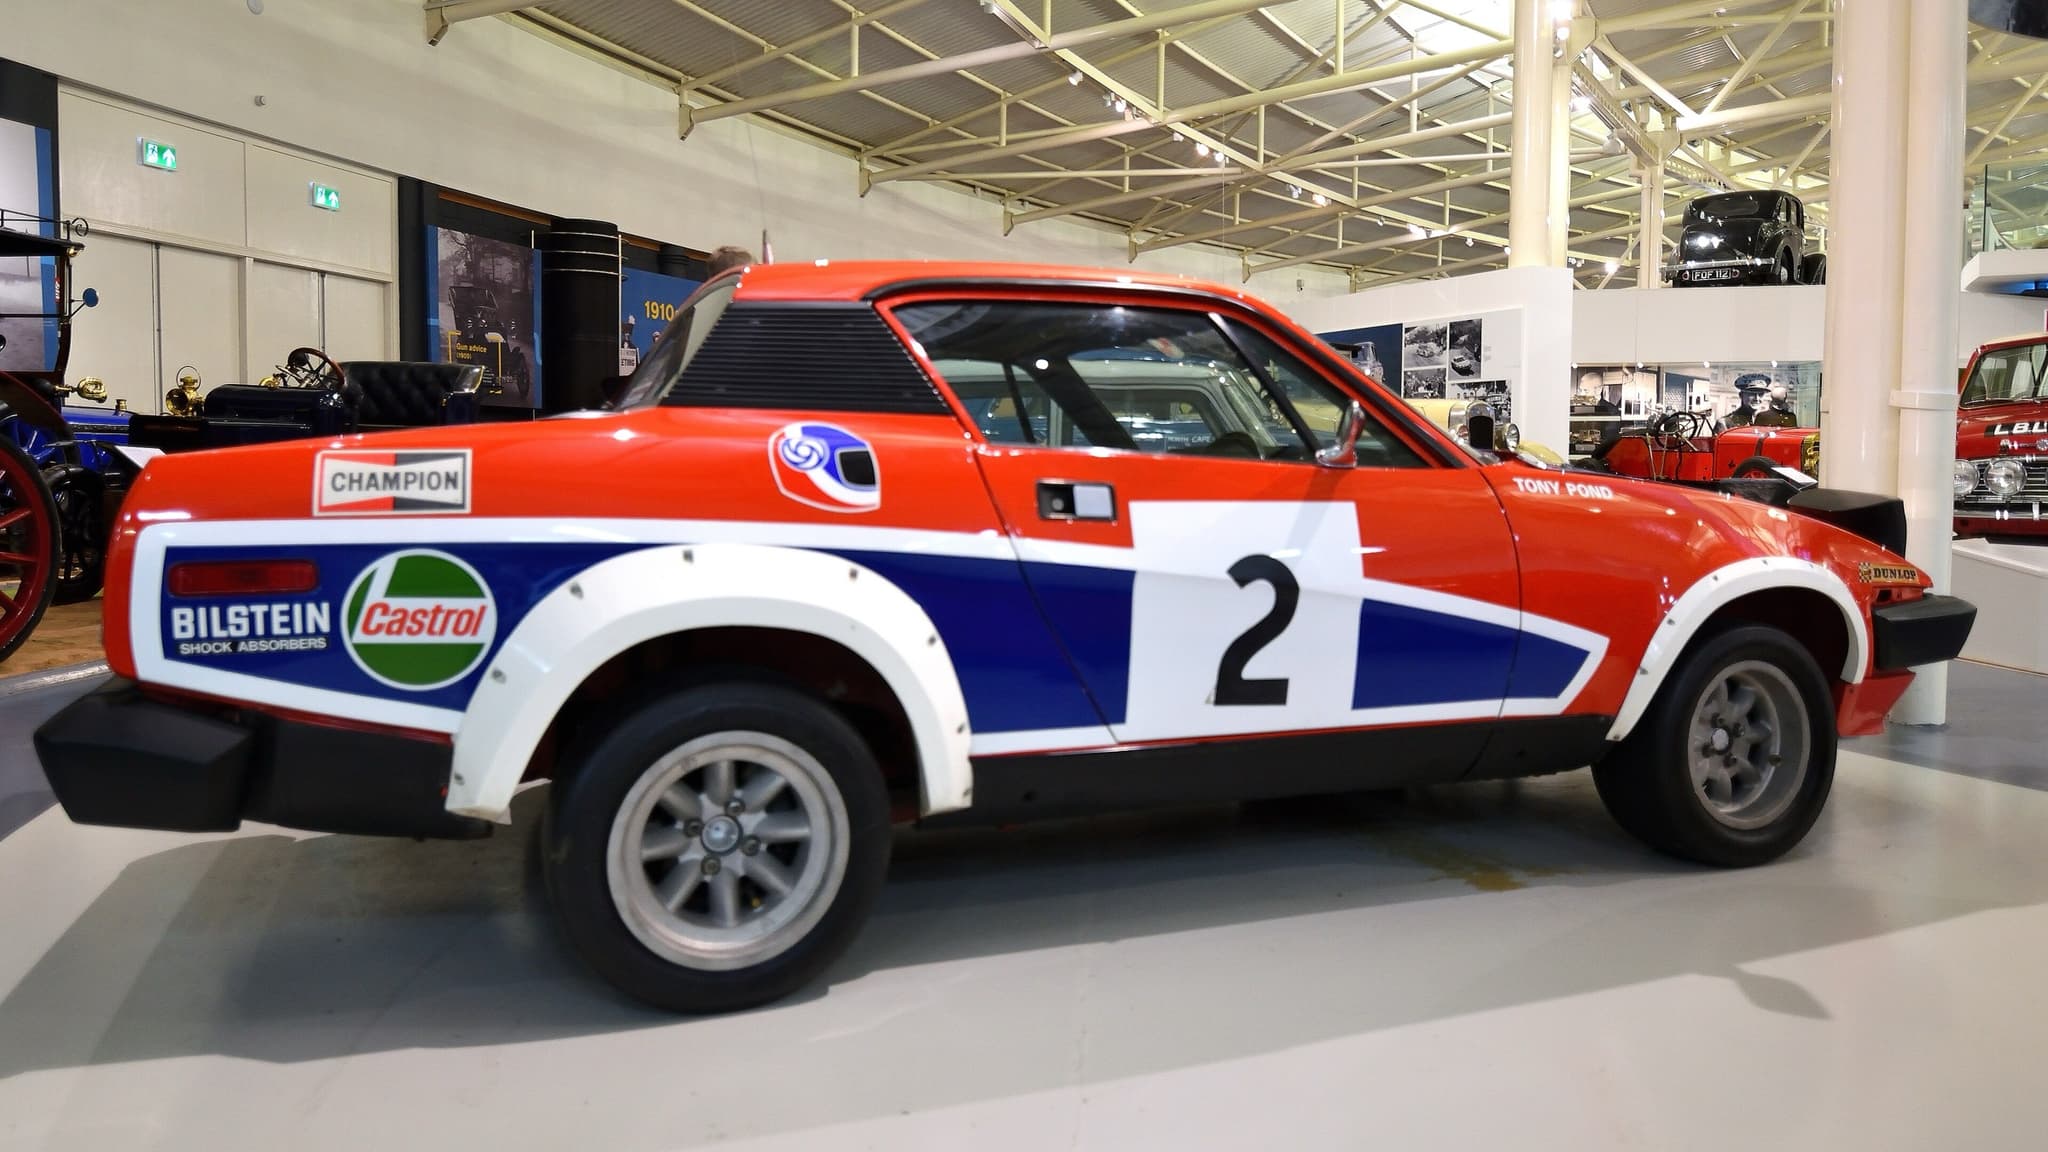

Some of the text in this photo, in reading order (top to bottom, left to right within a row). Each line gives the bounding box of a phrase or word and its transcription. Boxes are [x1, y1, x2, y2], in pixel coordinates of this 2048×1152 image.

[469, 344, 488, 353] advice
[331, 471, 459, 493] CHAMPION
[1512, 477, 1614, 500] TONY POND
[1872, 567, 1917, 580] DUNLOP
[171, 601, 331, 640] BILSTEIN
[360, 601, 487, 637] Castrol
[1213, 553, 1300, 706] 2
[179, 637, 328, 656] SHOCK ABSORBERS
